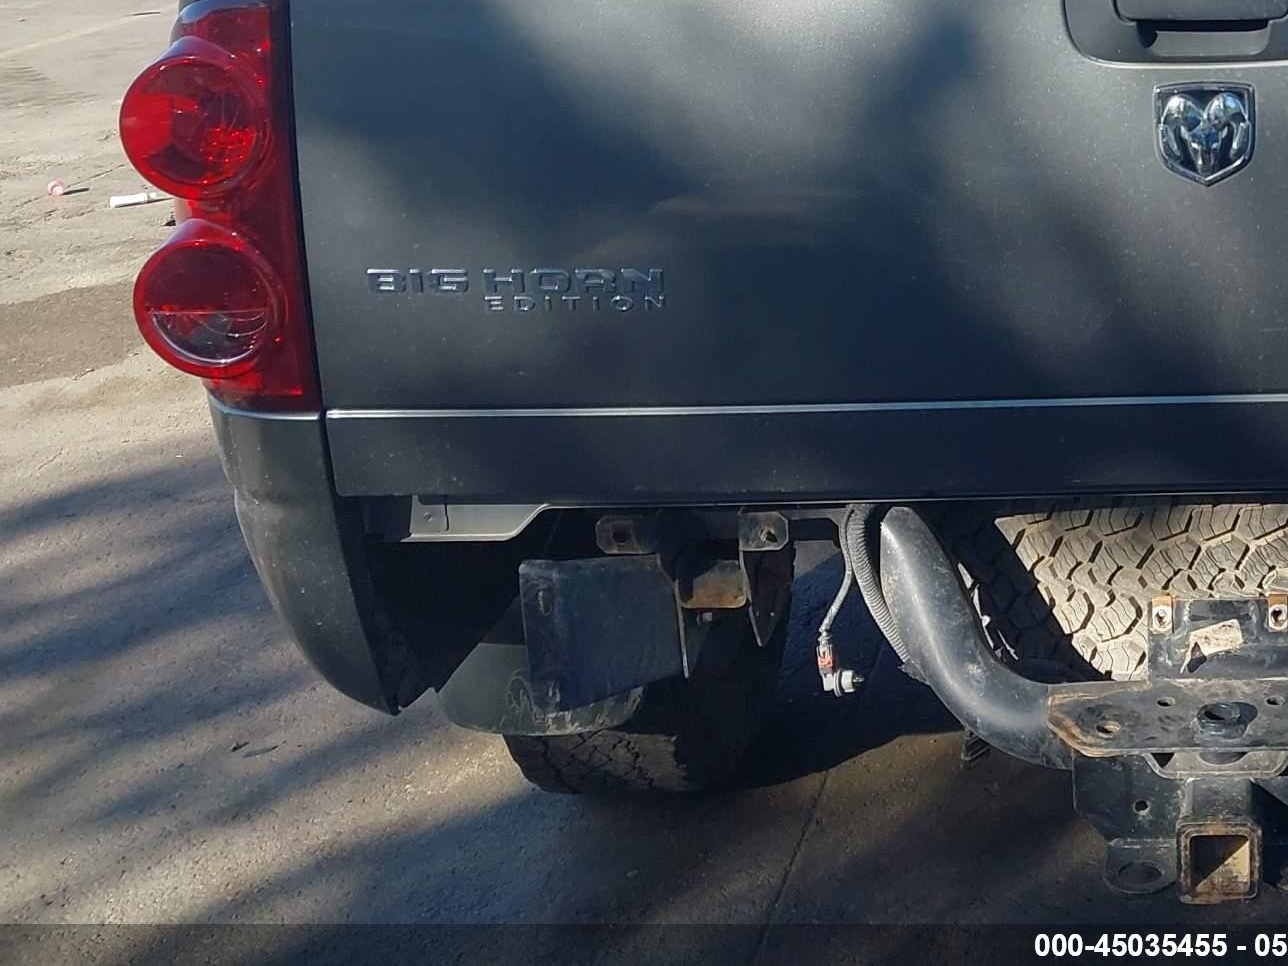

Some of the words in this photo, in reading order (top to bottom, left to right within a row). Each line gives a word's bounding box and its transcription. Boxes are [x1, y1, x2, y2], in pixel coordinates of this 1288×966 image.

[366, 267, 469, 294] BIG
[482, 267, 665, 294] HORN
[483, 294, 666, 313] EDITION
